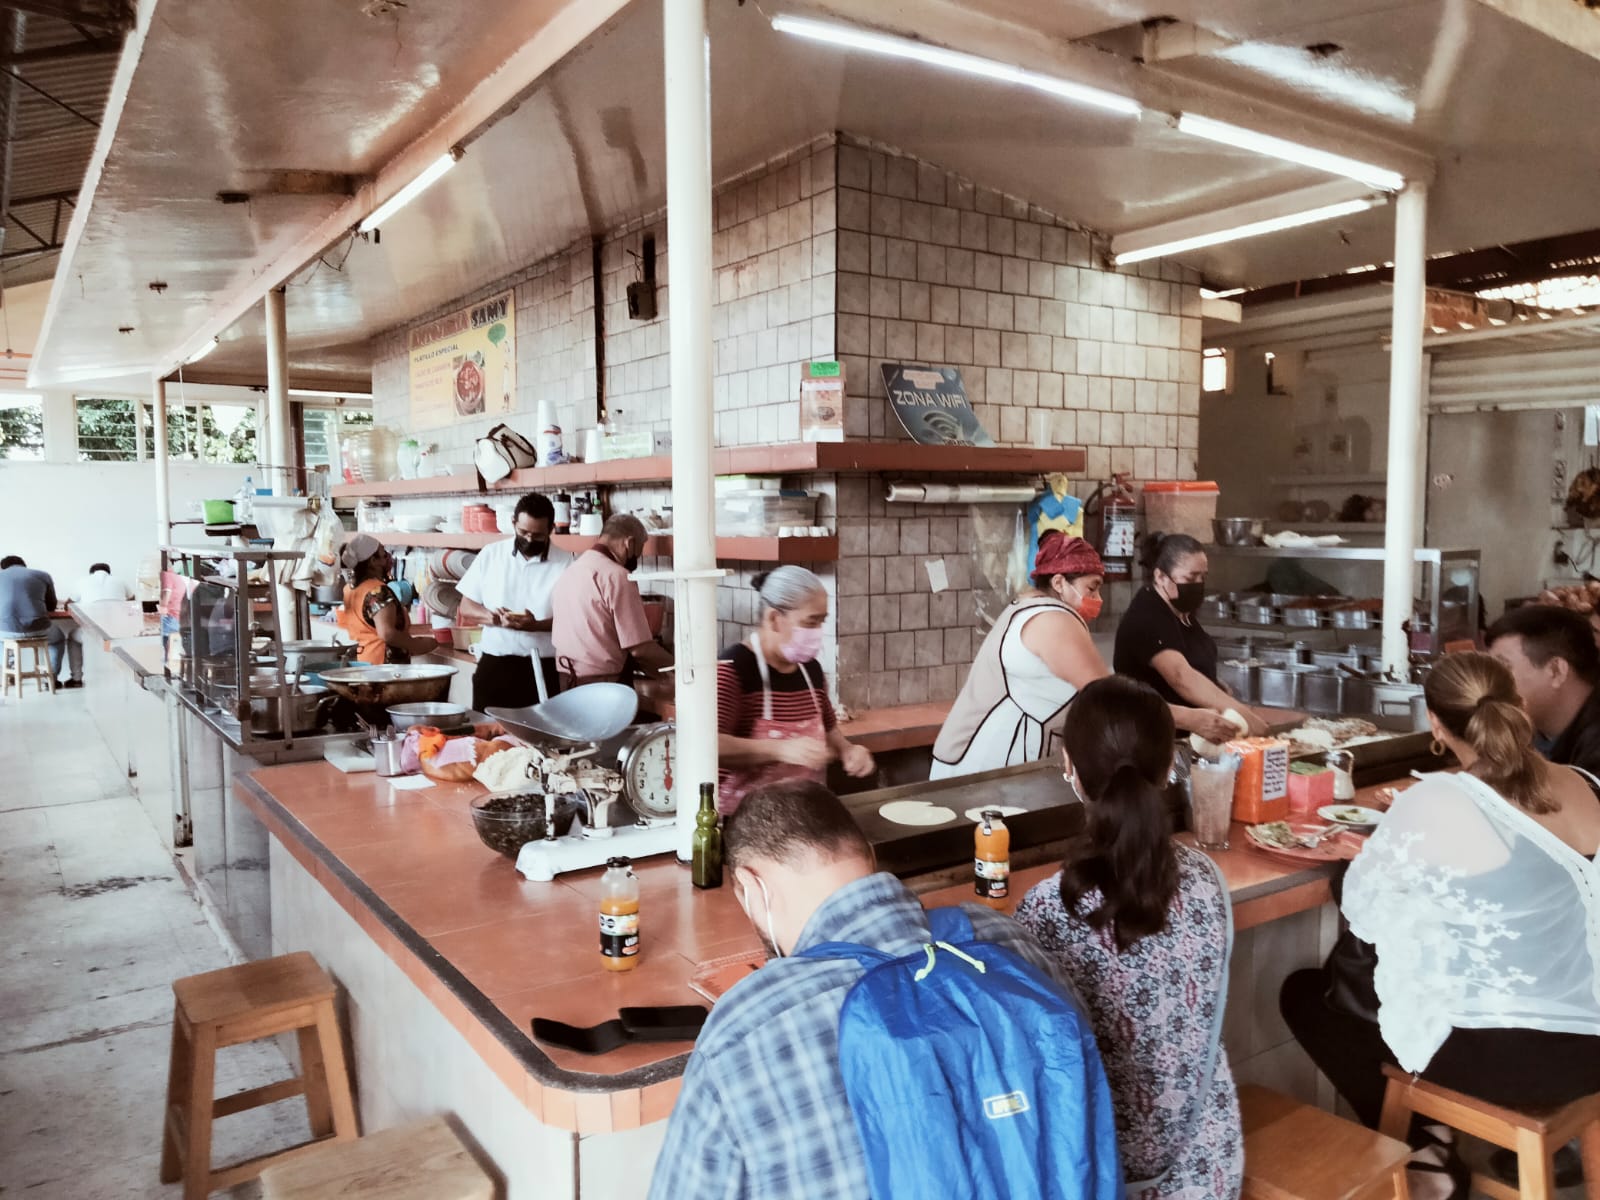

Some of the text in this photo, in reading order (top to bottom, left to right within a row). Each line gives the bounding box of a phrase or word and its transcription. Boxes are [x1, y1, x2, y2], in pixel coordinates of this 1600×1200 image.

[471, 294, 510, 329] SAMY
[435, 344, 459, 356] ESPECIAL
[893, 390, 967, 409] ZONA WIFI
[639, 762, 645, 772] 2
[639, 779, 645, 789] 3
[649, 792, 655, 801] 4
[664, 795, 670, 805] 5
